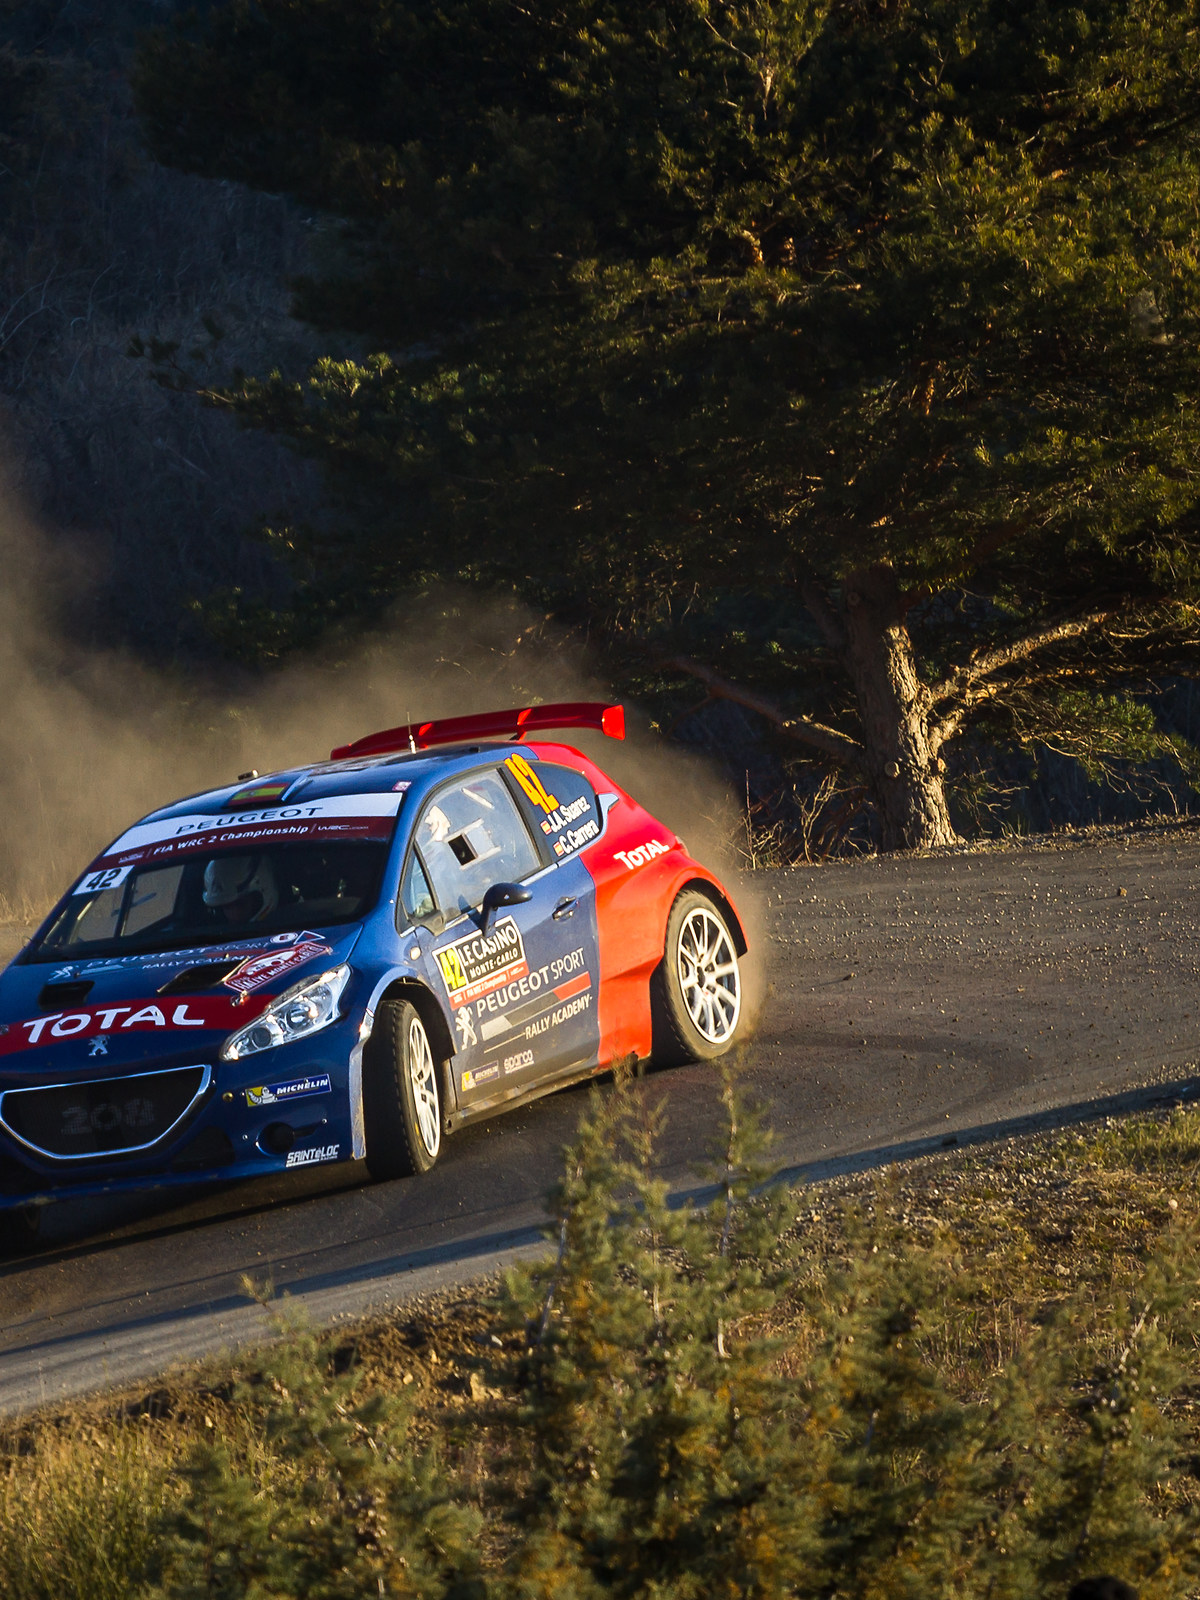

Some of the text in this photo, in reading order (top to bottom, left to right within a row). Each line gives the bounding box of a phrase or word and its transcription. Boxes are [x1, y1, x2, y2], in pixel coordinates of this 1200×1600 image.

[504, 753, 559, 814] 42
[176, 807, 323, 834] PEUGEOT
[153, 844, 173, 855] FIA
[177, 837, 204, 849] WRC
[208, 835, 217, 844] 2
[219, 825, 308, 842] Championship
[613, 839, 670, 870] TOTAL
[85, 868, 122, 890] 42
[458, 925, 518, 967] LE CASINO
[439, 948, 467, 990] 42
[476, 947, 585, 1018] PEUGEOT SPORT
[22, 1004, 205, 1043] TOTAL
[525, 994, 591, 1040] RALLY ACADEMY
[503, 1049, 533, 1071] sparco
[276, 1079, 328, 1095] MICHELIN
